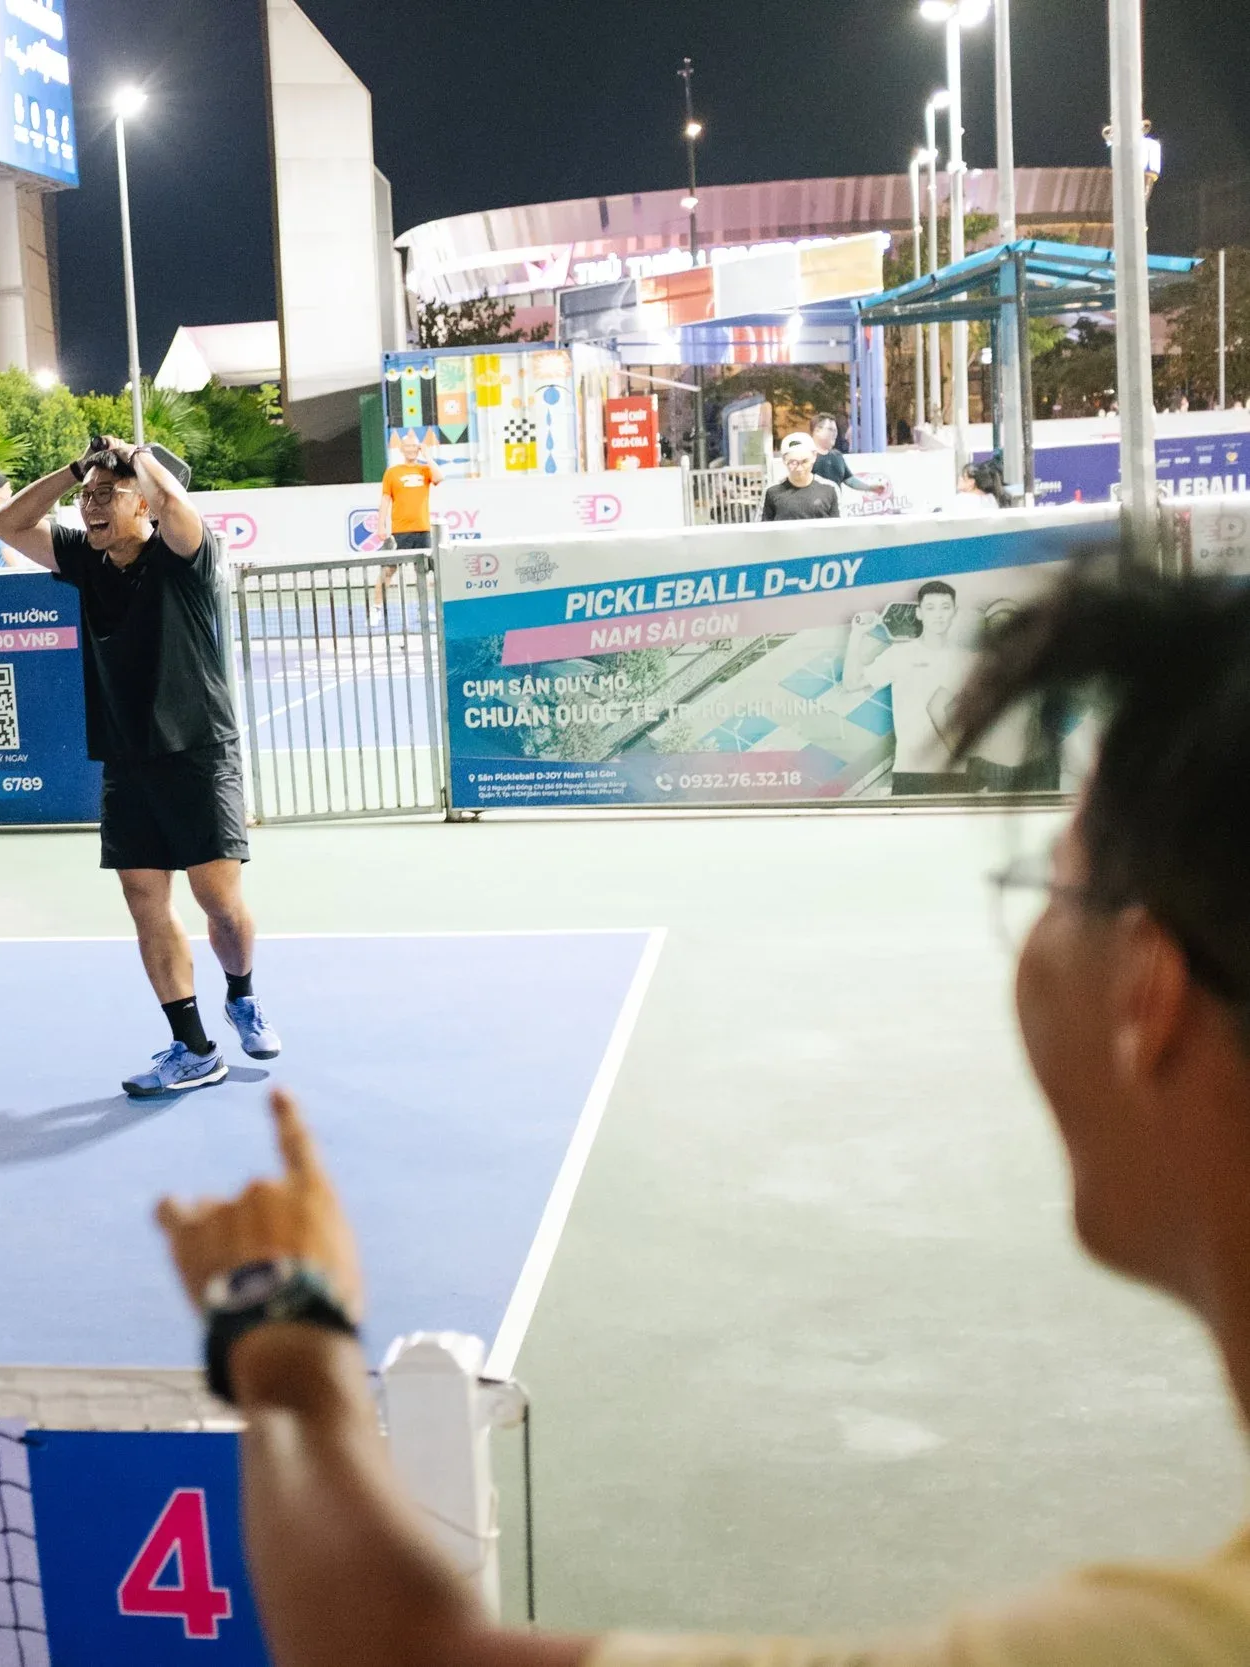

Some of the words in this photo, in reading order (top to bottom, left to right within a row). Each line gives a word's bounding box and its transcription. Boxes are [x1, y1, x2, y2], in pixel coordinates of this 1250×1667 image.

[465, 580, 499, 589] D-JOY
[565, 572, 756, 620] PICKLEBALL
[763, 557, 865, 597] D-JOY
[0, 607, 58, 625] THƯỞNG
[590, 624, 643, 650] NAM
[646, 616, 685, 643] SÀI
[691, 610, 740, 637] GÒN
[18, 631, 59, 648] VNĐ
[462, 680, 501, 698] CỤM
[508, 674, 550, 696] SÂN
[599, 672, 628, 693] MÔ
[464, 697, 551, 728] CHUẨN
[771, 699, 821, 717] MINH
[5, 754, 28, 763] NGAY
[2, 776, 43, 791] 6789
[495, 772, 534, 781] Pickleball
[536, 772, 562, 780] D-JOY
[564, 771, 583, 779] Nam
[678, 770, 801, 789] 0932.76.32.18
[117, 1487, 232, 1639] 4
